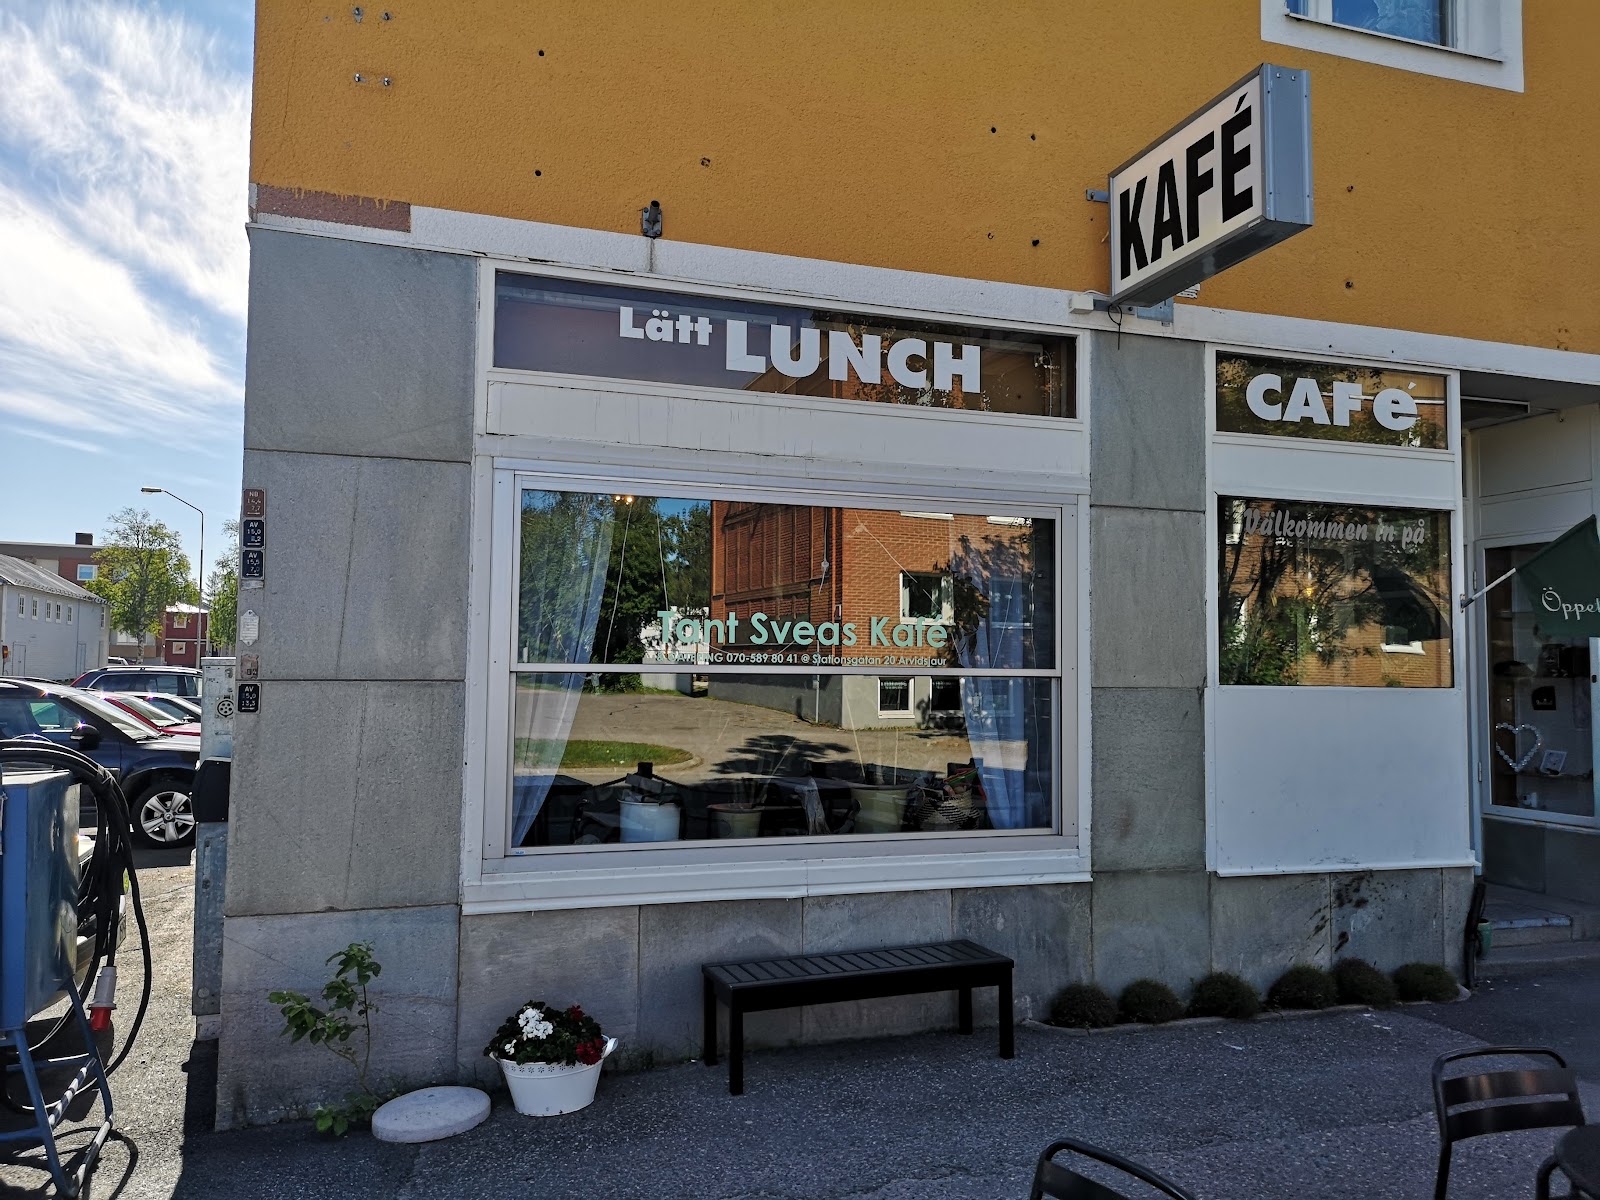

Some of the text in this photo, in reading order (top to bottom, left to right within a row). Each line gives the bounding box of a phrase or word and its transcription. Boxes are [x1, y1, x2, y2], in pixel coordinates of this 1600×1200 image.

[1119, 91, 1254, 281] KAFÉ
[619, 306, 981, 394] Lätt LUNCH
[1243, 507, 1426, 550] Välkommen in på
[657, 610, 948, 648] Tant Sveas Kafé
[726, 652, 768, 663] 070-589
[770, 653, 784, 664] 80
[786, 653, 798, 664] 41
[812, 654, 881, 666] Stationsgatan
[884, 655, 896, 665] 20
[899, 655, 947, 667] Arvidsjaur
